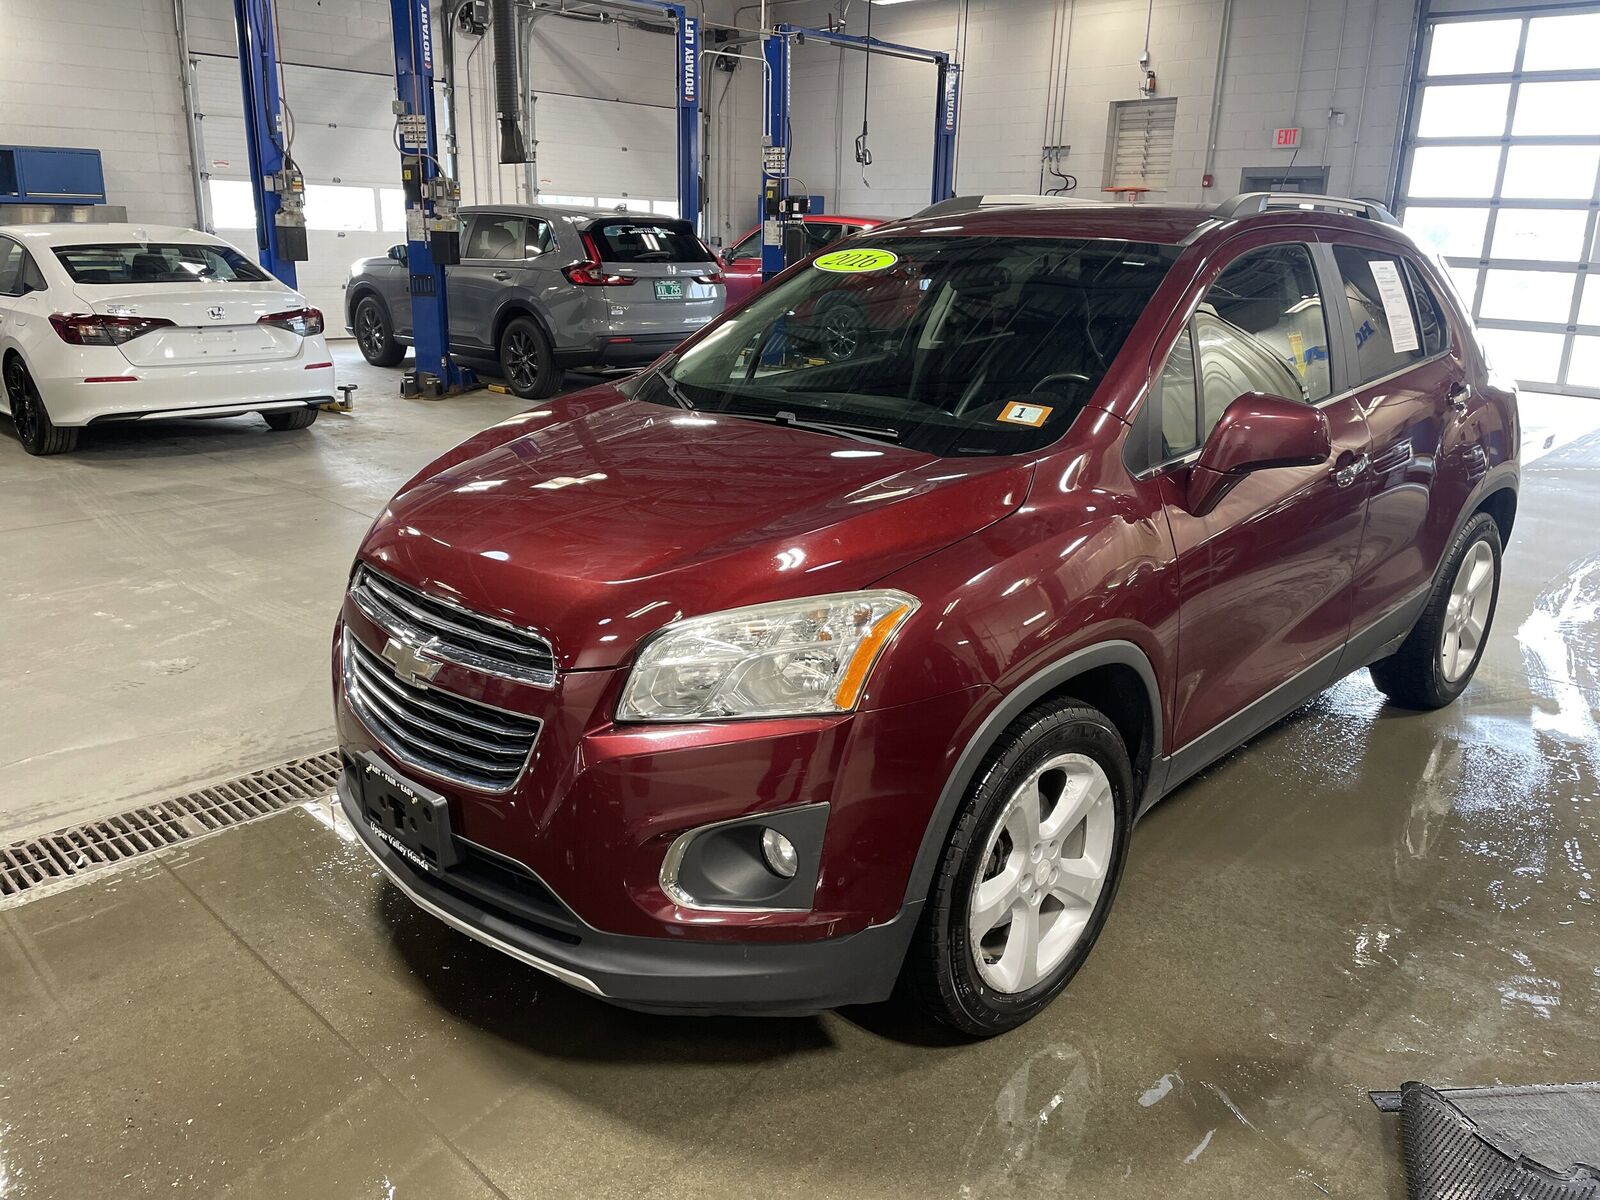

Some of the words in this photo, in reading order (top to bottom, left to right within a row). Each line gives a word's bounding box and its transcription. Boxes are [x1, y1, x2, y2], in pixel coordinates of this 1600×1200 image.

[421, 4, 430, 61] ROTARY
[685, 19, 694, 44] LIFT
[685, 47, 694, 95] ROTARY
[946, 87, 955, 125] ROTARY
[1277, 129, 1297, 145] EXIT
[823, 254, 889, 268] 2016
[1014, 407, 1026, 418] 1
[370, 821, 387, 840] Upper
[388, 834, 406, 856] Valley
[407, 849, 429, 871] Honda
